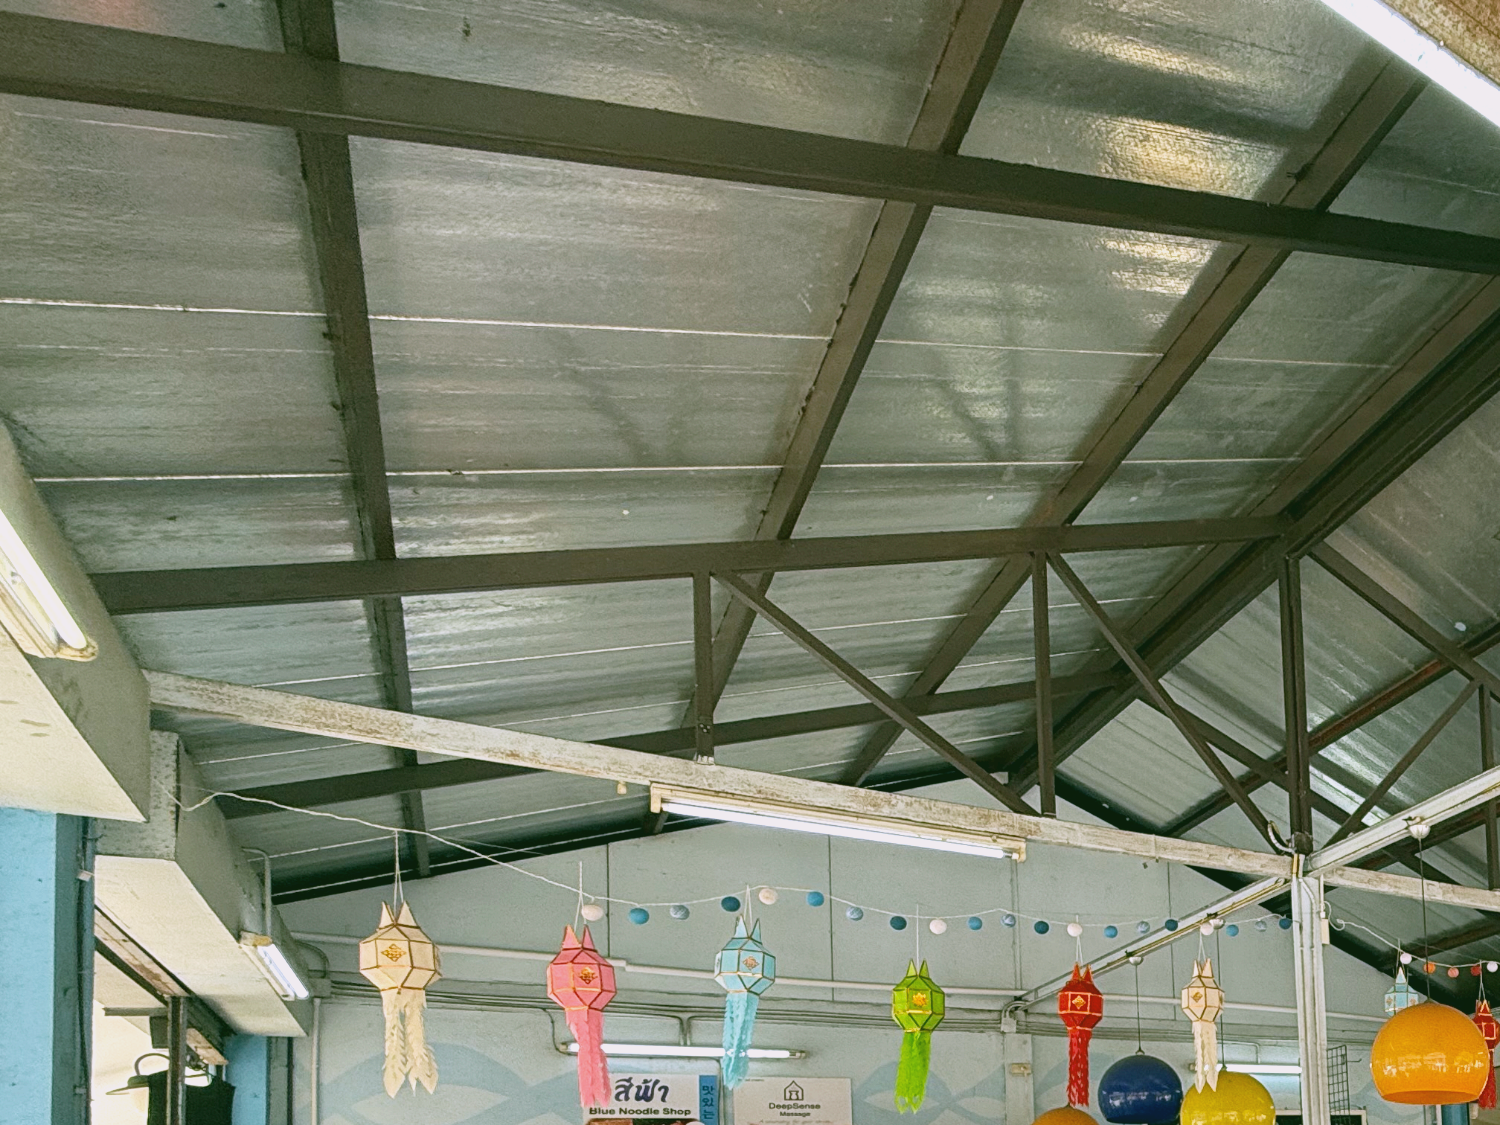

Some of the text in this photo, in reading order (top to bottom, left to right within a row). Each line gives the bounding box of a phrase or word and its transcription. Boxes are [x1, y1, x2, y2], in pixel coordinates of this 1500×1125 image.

[614, 1076, 670, 1103] สีฟ้า
[588, 1106, 692, 1117] Blue Noodle Shop
[768, 1102, 821, 1111] DeepSense
